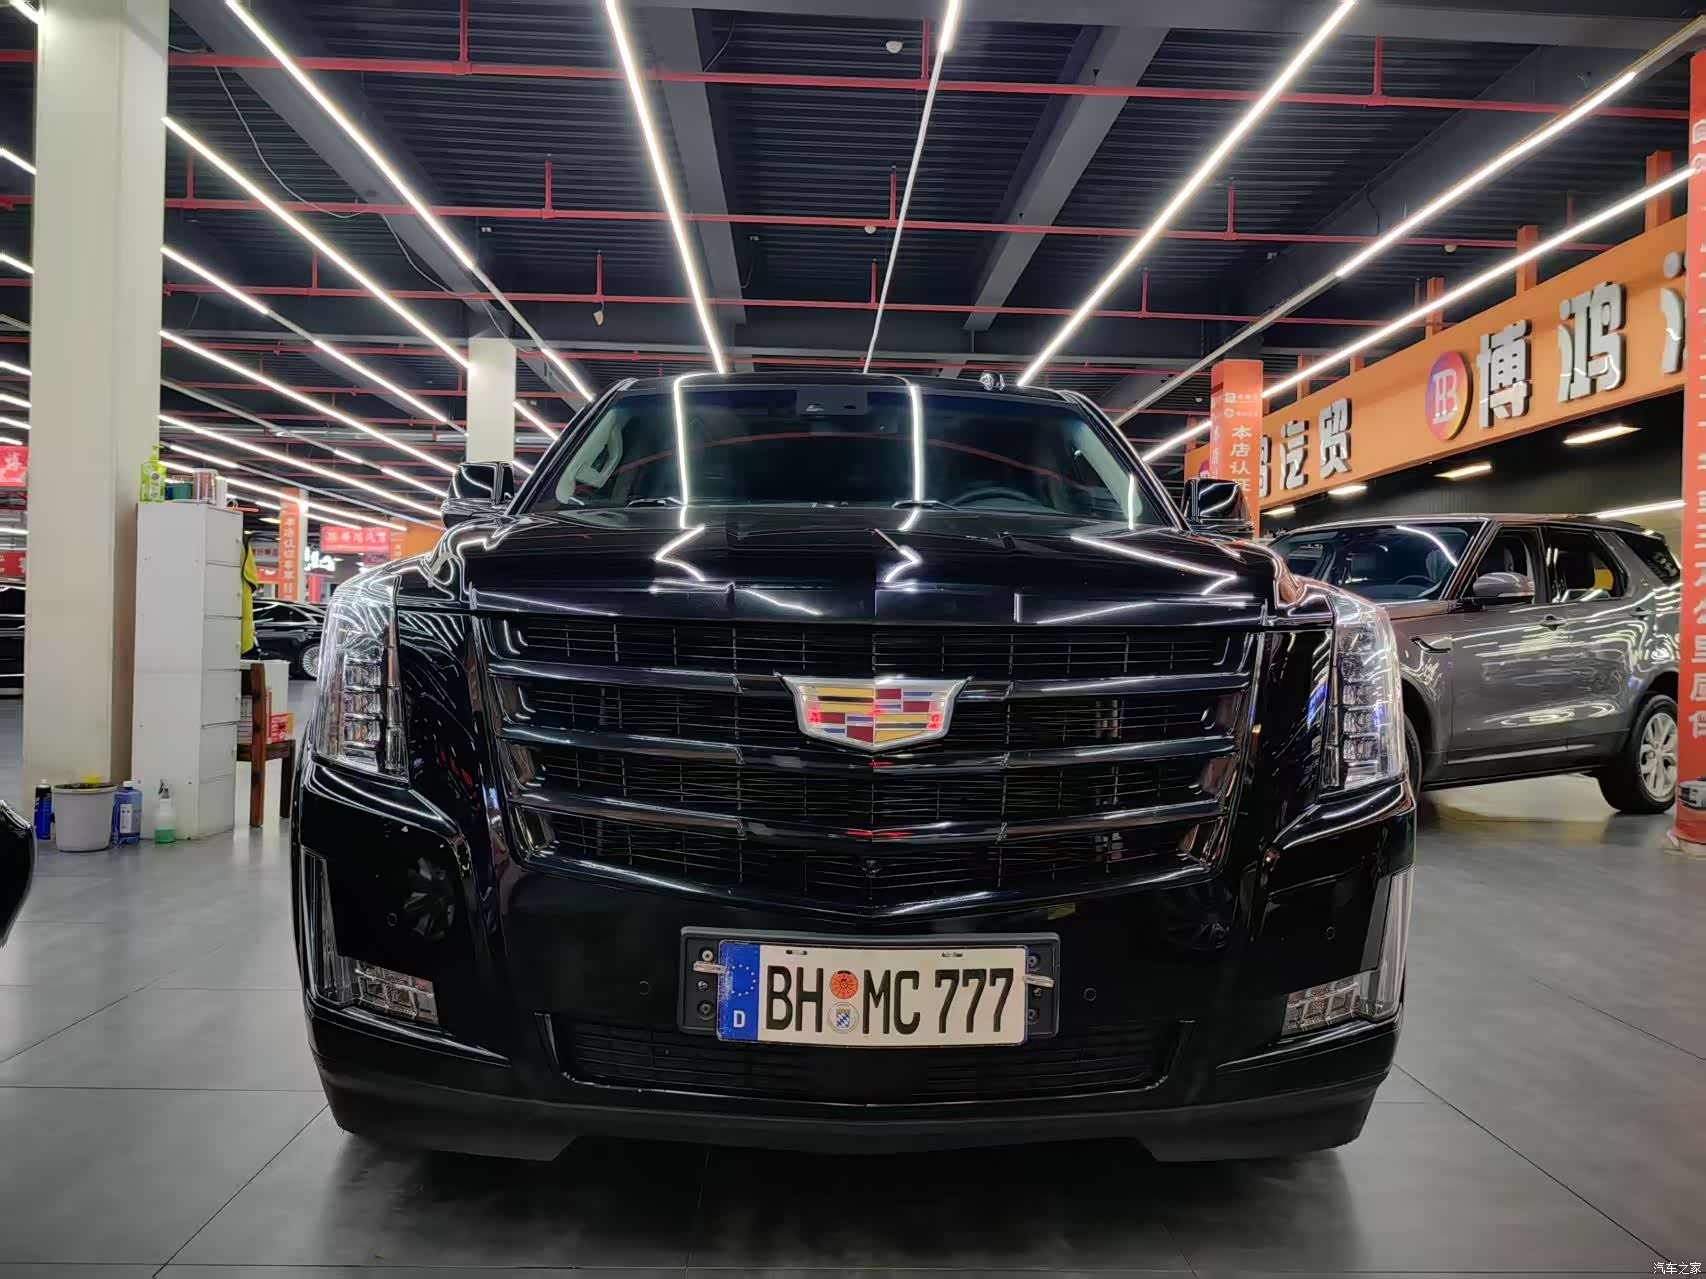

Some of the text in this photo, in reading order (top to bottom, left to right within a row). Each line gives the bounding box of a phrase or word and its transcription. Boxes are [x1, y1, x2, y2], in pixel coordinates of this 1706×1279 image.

[733, 1010, 746, 1028] D
[766, 965, 1014, 1035] BH MC 777
